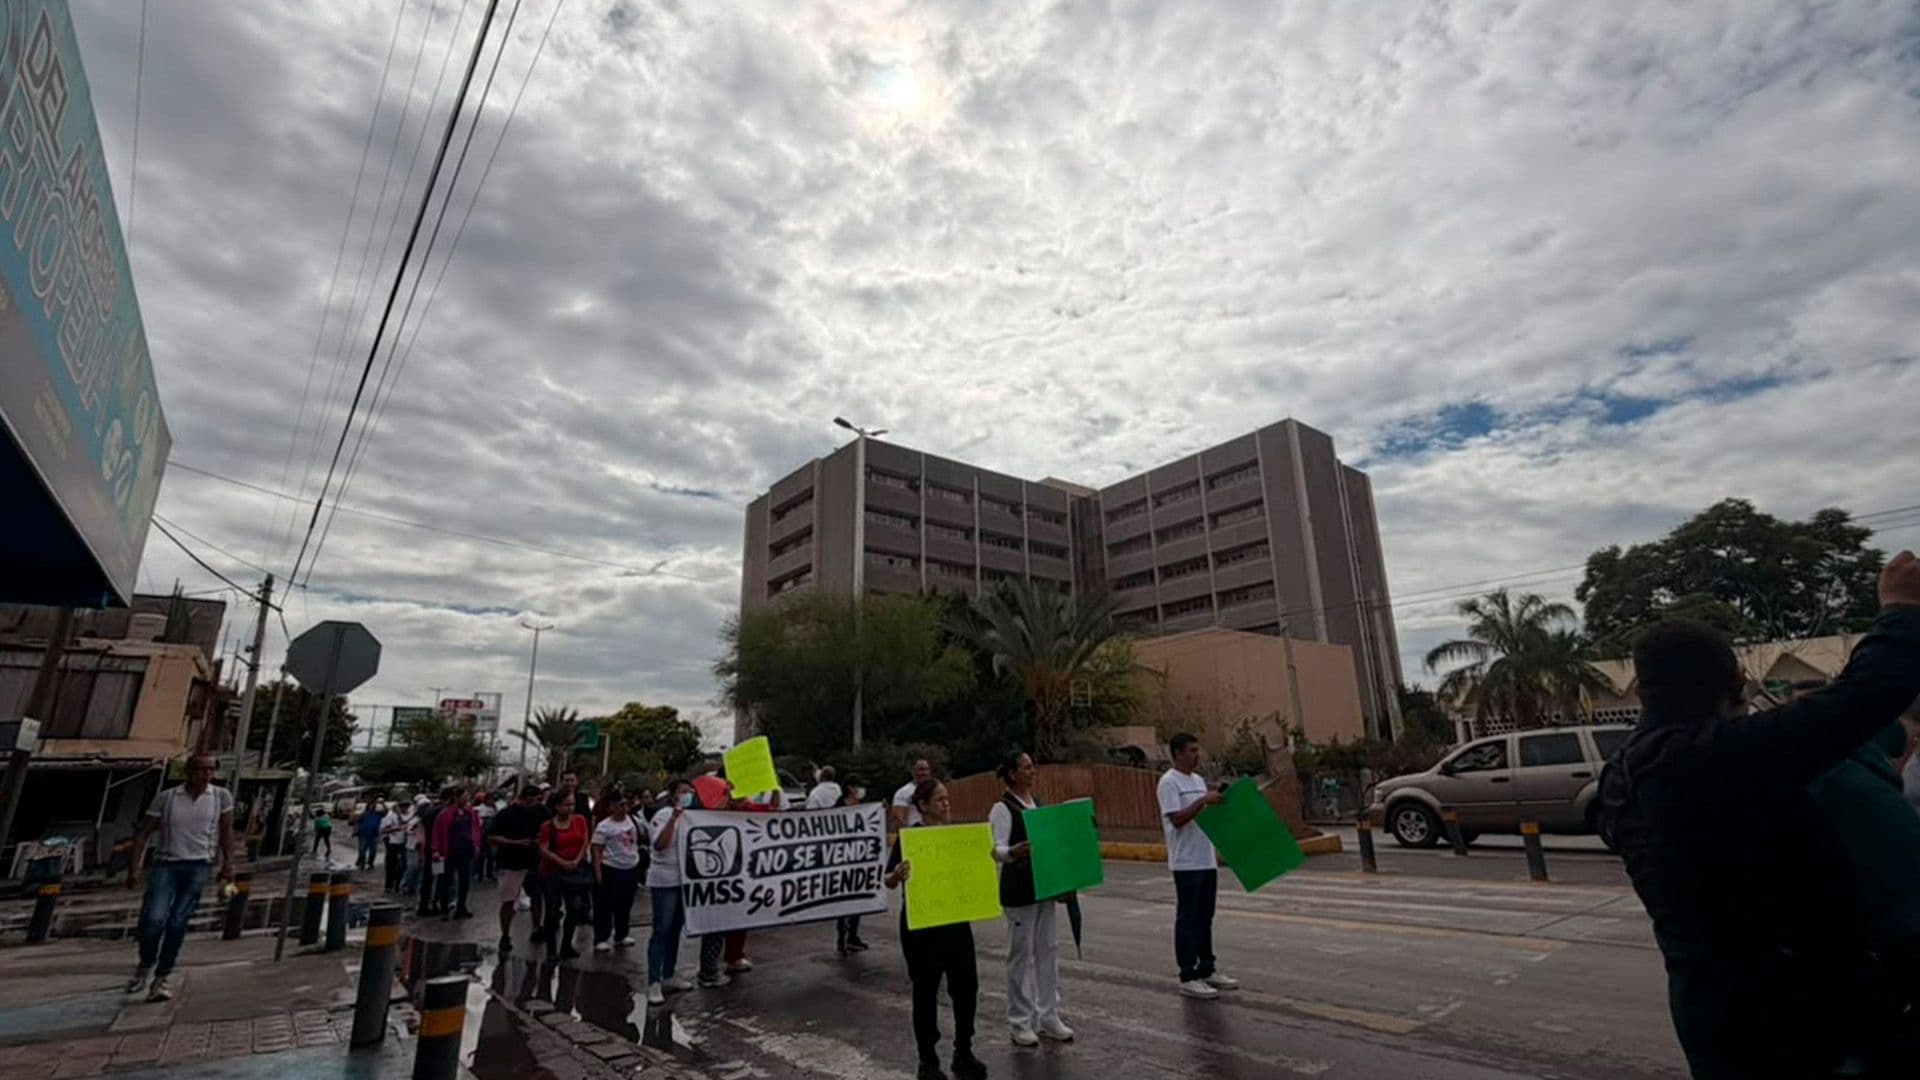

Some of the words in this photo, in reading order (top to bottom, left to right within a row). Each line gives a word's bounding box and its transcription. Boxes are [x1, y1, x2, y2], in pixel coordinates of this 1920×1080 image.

[24, 7, 69, 166] DEL
[766, 812, 865, 840] COAHUILA
[755, 849, 787, 877] NO
[793, 845, 817, 869] SE
[822, 838, 878, 866] VENDE
[684, 878, 745, 907] IMSS
[746, 884, 775, 915] Se
[780, 864, 883, 907] DEFIENDE!
